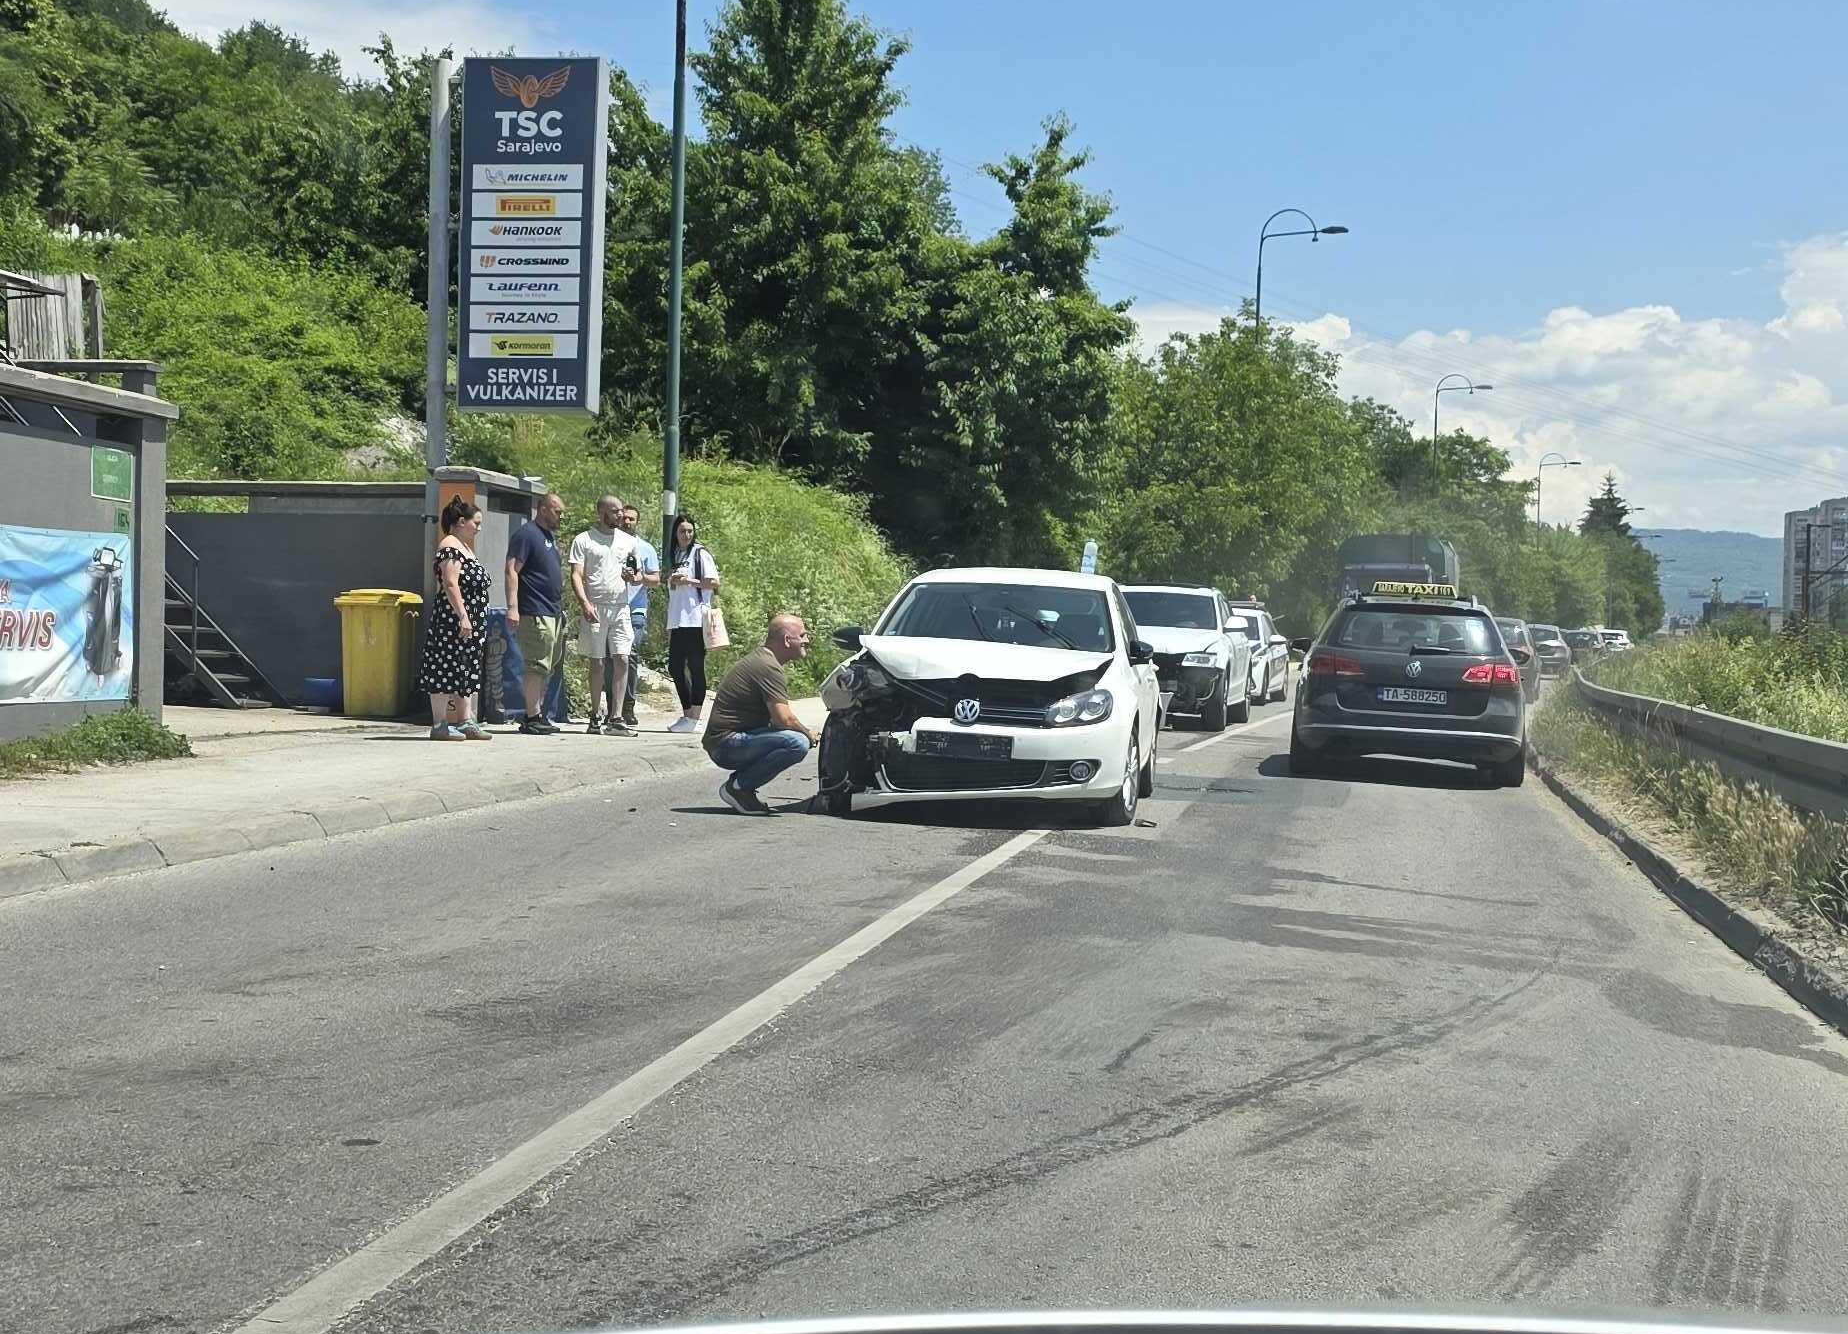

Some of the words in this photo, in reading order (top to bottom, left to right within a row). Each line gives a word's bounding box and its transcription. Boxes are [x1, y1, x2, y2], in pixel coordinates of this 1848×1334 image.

[494, 110, 563, 137] TSC
[496, 139, 562, 155] Sarajevo
[507, 173, 568, 182] MICHELIN
[500, 199, 551, 212] PIRELLI
[497, 258, 570, 266] CROSSWIND
[487, 368, 548, 384] SERVIS
[552, 369, 557, 384] I
[466, 385, 577, 401] VULKANIZER
[1405, 583, 1439, 595] TAXI
[0, 609, 55, 651] RVIS
